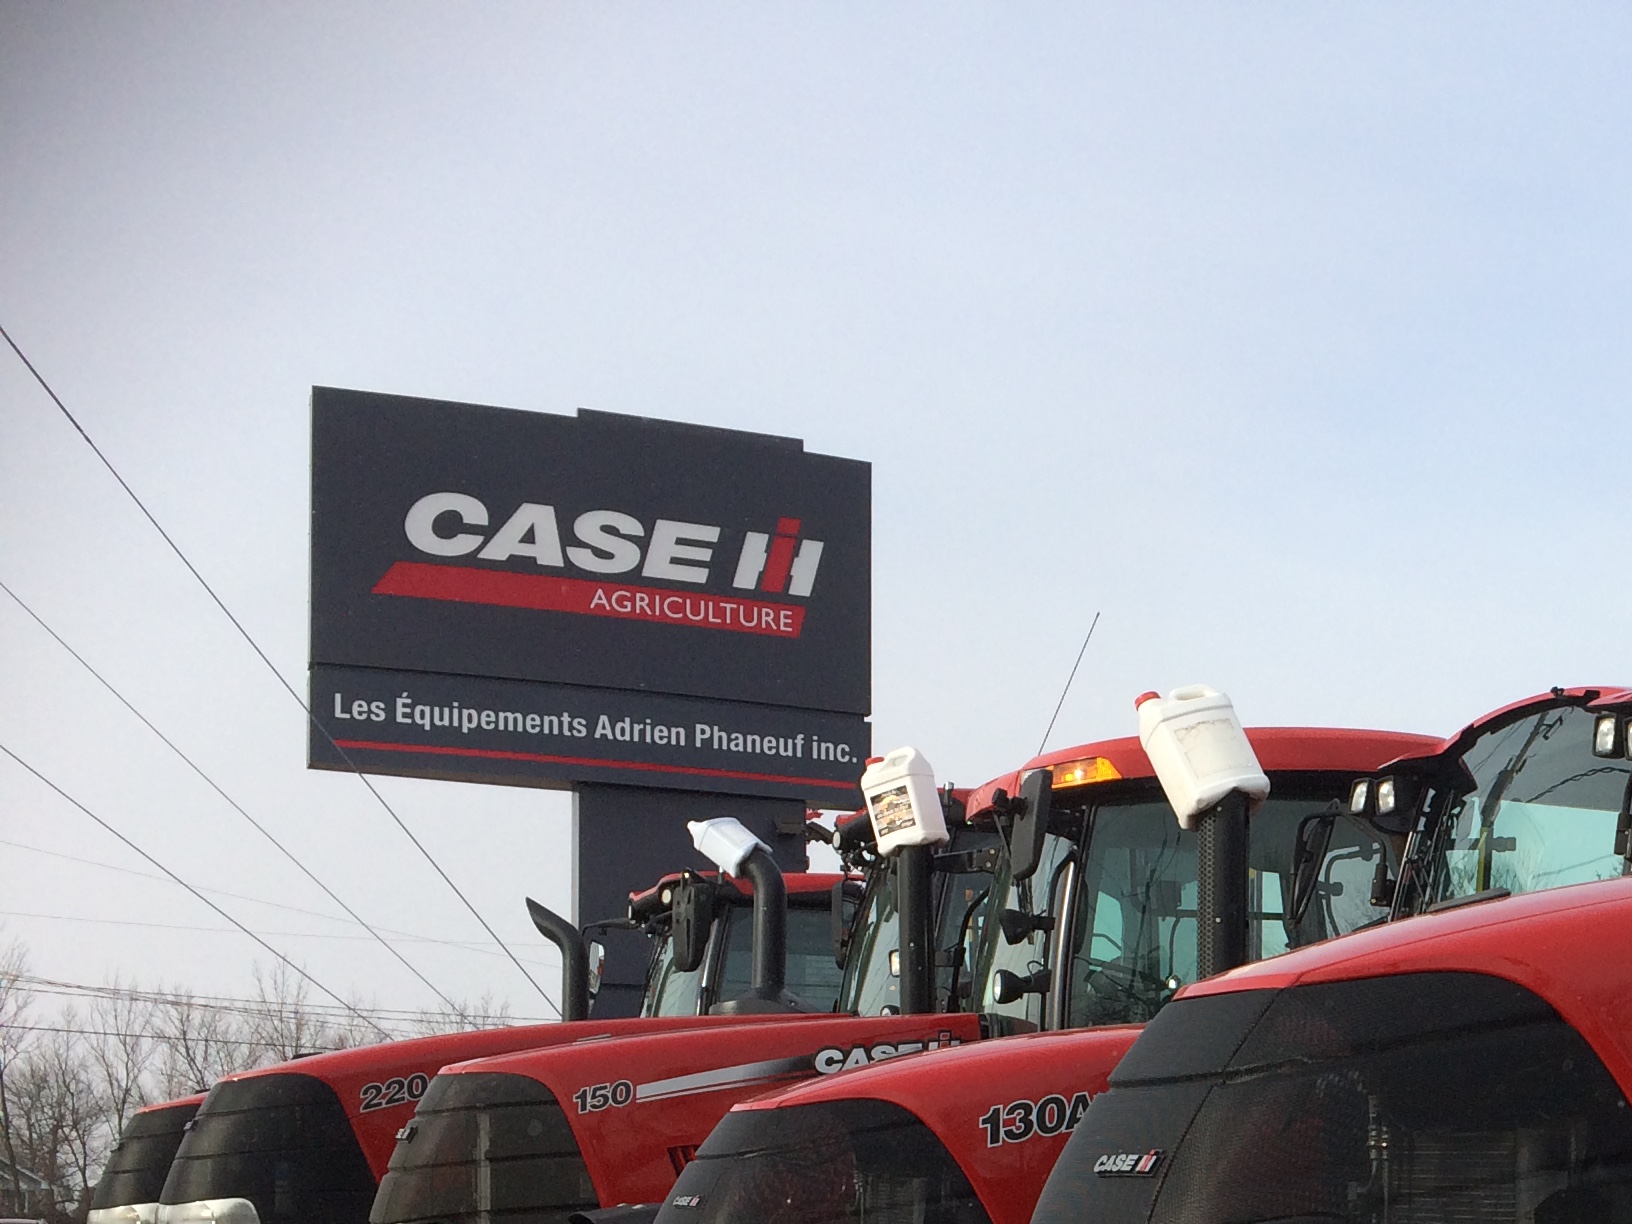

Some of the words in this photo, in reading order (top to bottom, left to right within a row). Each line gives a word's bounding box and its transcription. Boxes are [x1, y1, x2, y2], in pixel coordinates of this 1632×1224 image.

[404, 491, 721, 584] CASE
[589, 588, 794, 633] AGRICULTURE
[334, 692, 387, 721] Les
[395, 691, 588, 738] Équipements
[594, 714, 686, 746] Adrien
[694, 723, 805, 758] Phaneuf
[812, 735, 859, 764] inc.
[360, 1073, 429, 1113] 220
[573, 1079, 633, 1115] 150
[1093, 1153, 1140, 1173] CASE
